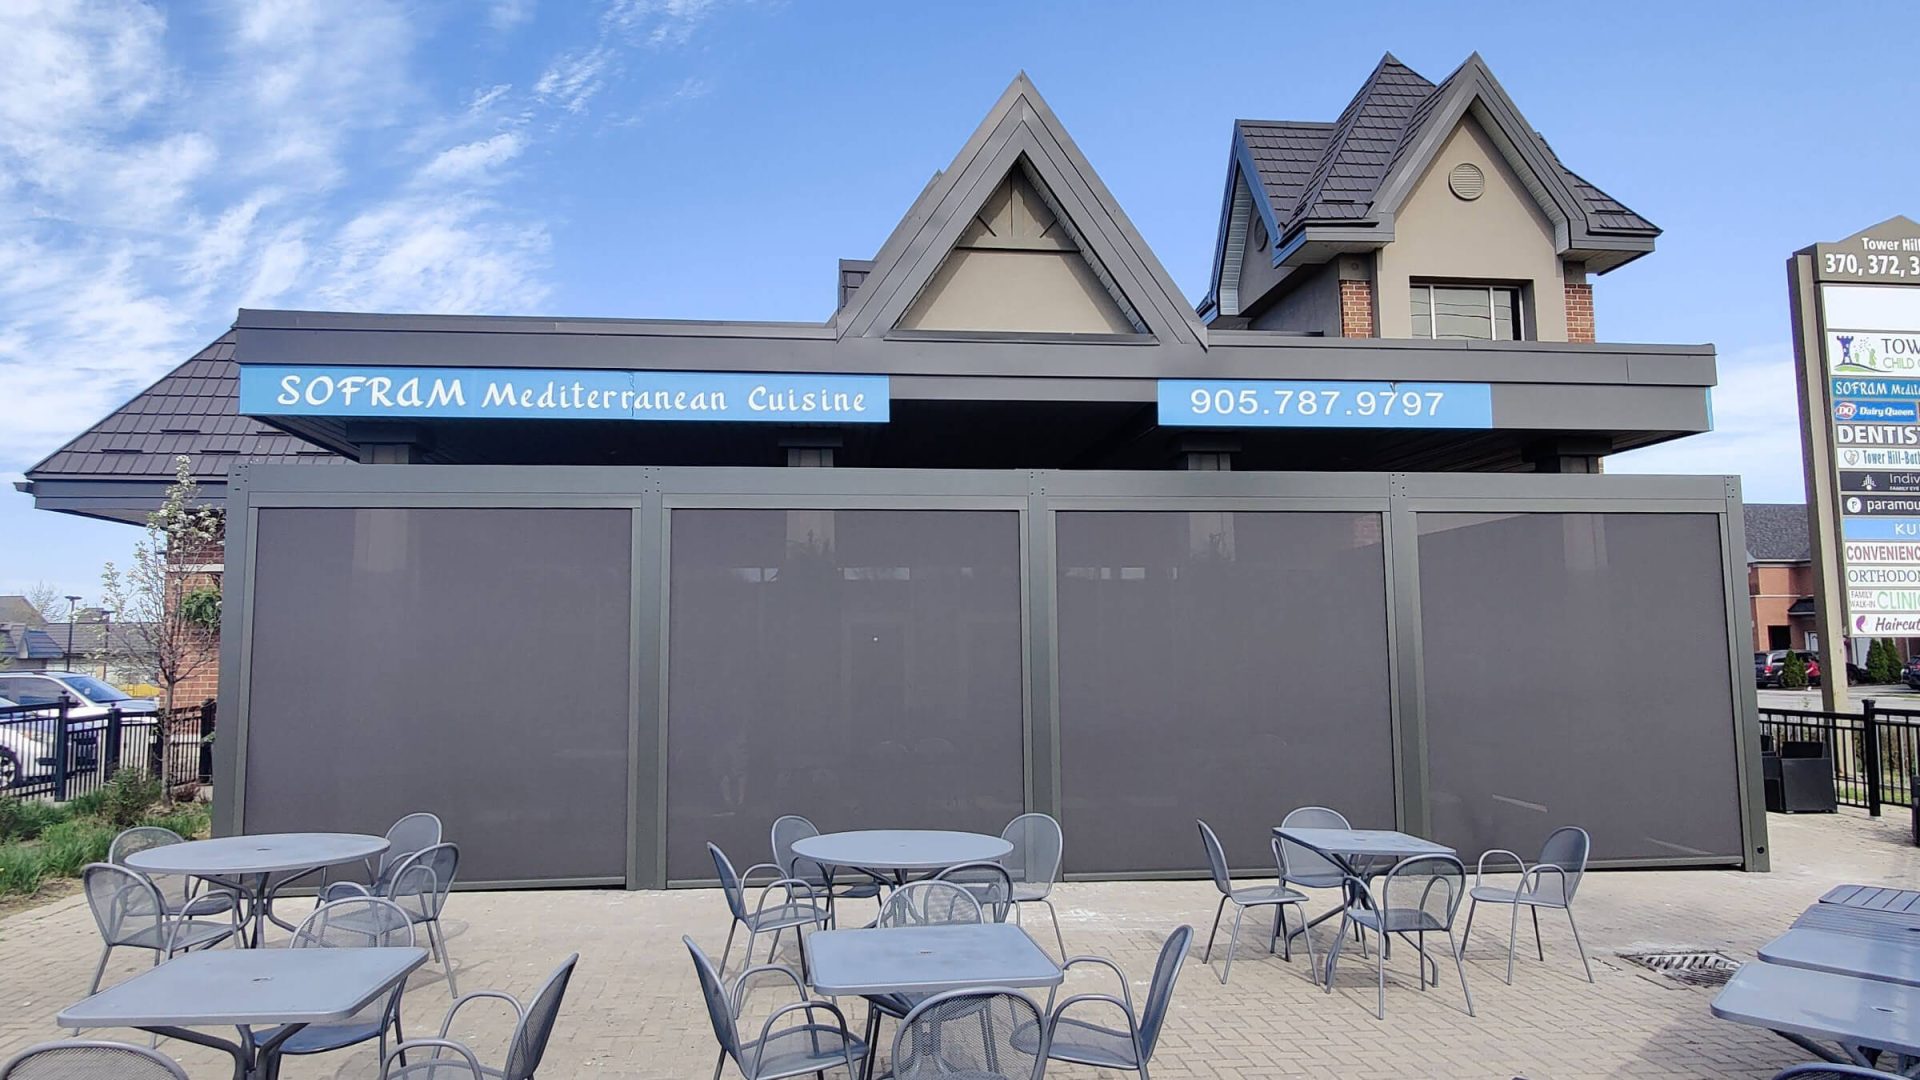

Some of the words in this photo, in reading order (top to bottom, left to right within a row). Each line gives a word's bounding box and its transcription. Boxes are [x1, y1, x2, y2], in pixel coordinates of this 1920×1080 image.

[1861, 237, 1900, 251] Tower
[1825, 253, 1863, 276] 370,
[1867, 255, 1905, 278] 372,
[1882, 357, 1915, 369] CHILD
[277, 375, 467, 408] SOFRAM
[481, 379, 728, 412] Mediterranean
[748, 385, 867, 413] Cuisine
[1835, 381, 1888, 396] SOFRAM
[1190, 388, 1445, 417] 905.787.9797
[1859, 406, 1884, 417] Dairy
[1837, 425, 1920, 445] DENTIS
[1862, 450, 1885, 464] Tower
[1895, 523, 1920, 535] KU
[1851, 591, 1873, 599] FAMILY
[1850, 600, 1876, 608] WALK-IN
